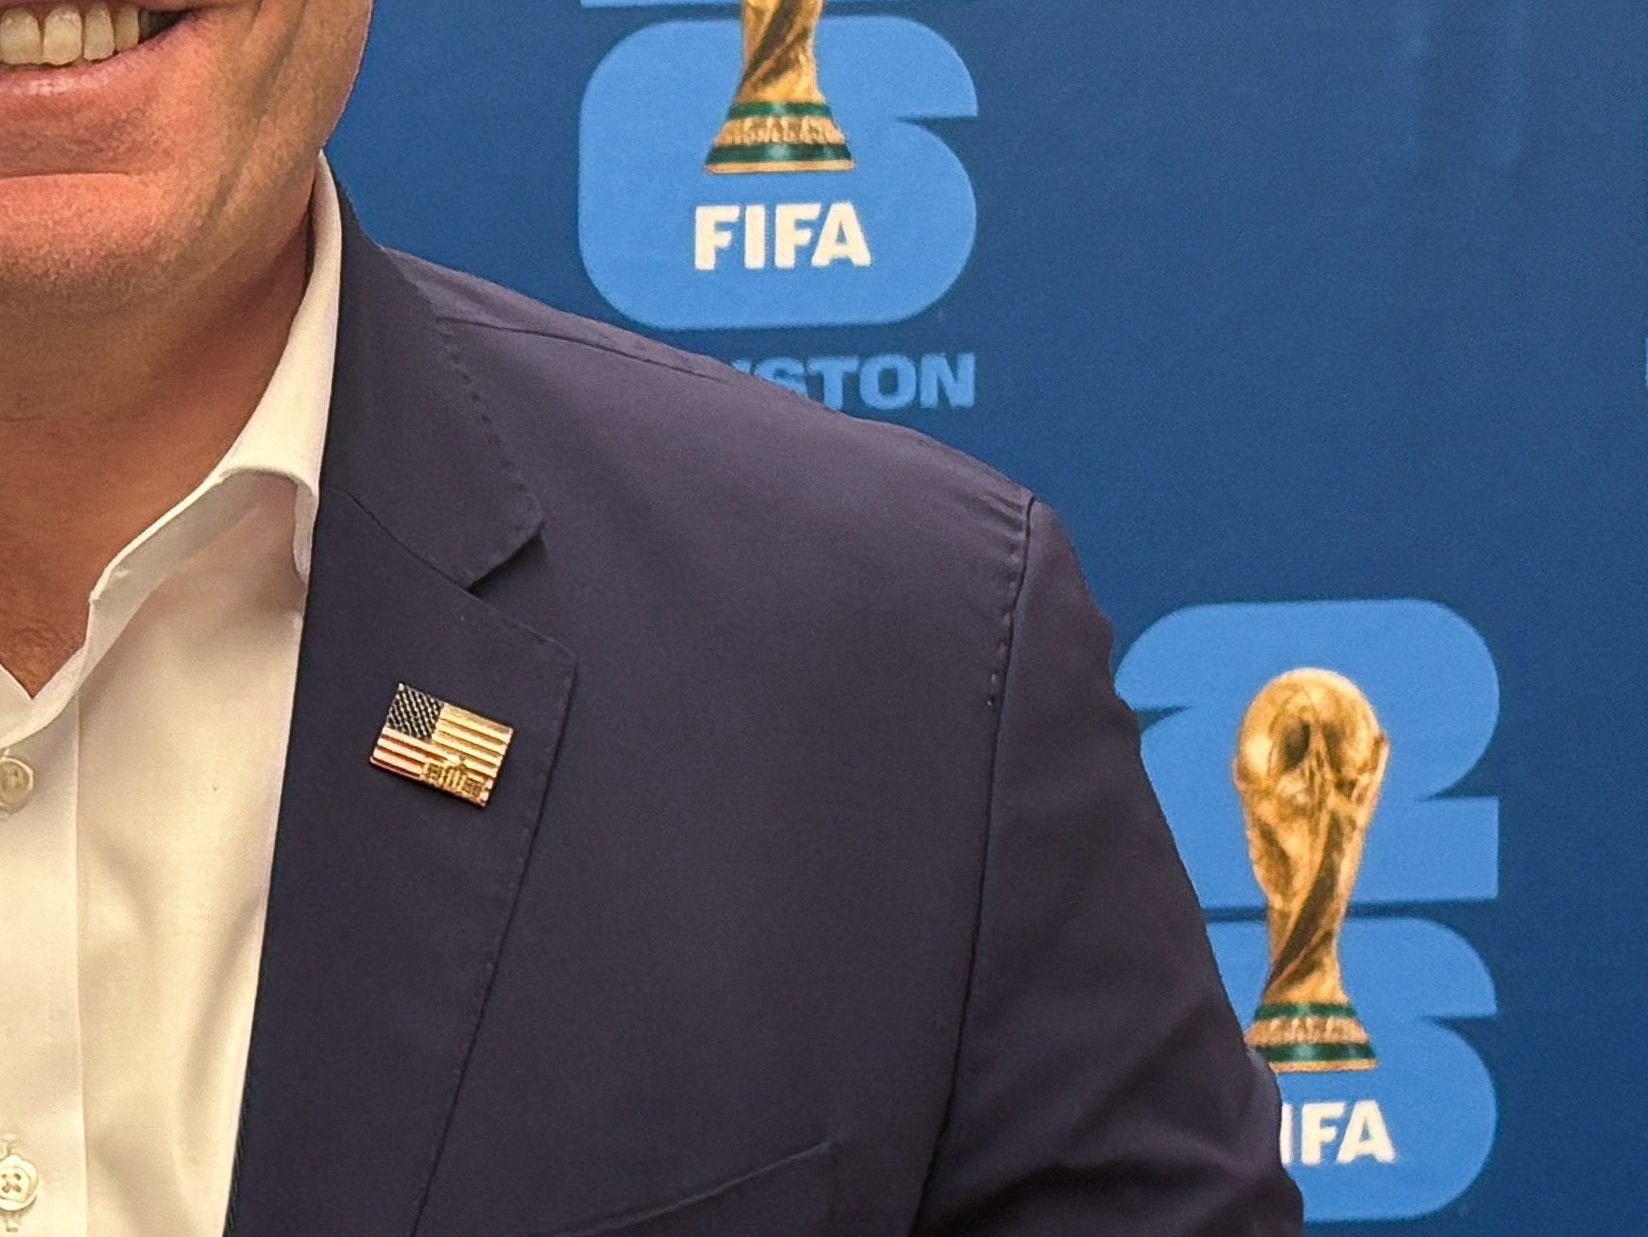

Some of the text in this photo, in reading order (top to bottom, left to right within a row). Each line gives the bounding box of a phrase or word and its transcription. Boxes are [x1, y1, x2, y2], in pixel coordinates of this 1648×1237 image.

[693, 202, 872, 271] FIFA
[731, 352, 977, 410] STON
[1280, 1099, 1396, 1166] IFA
